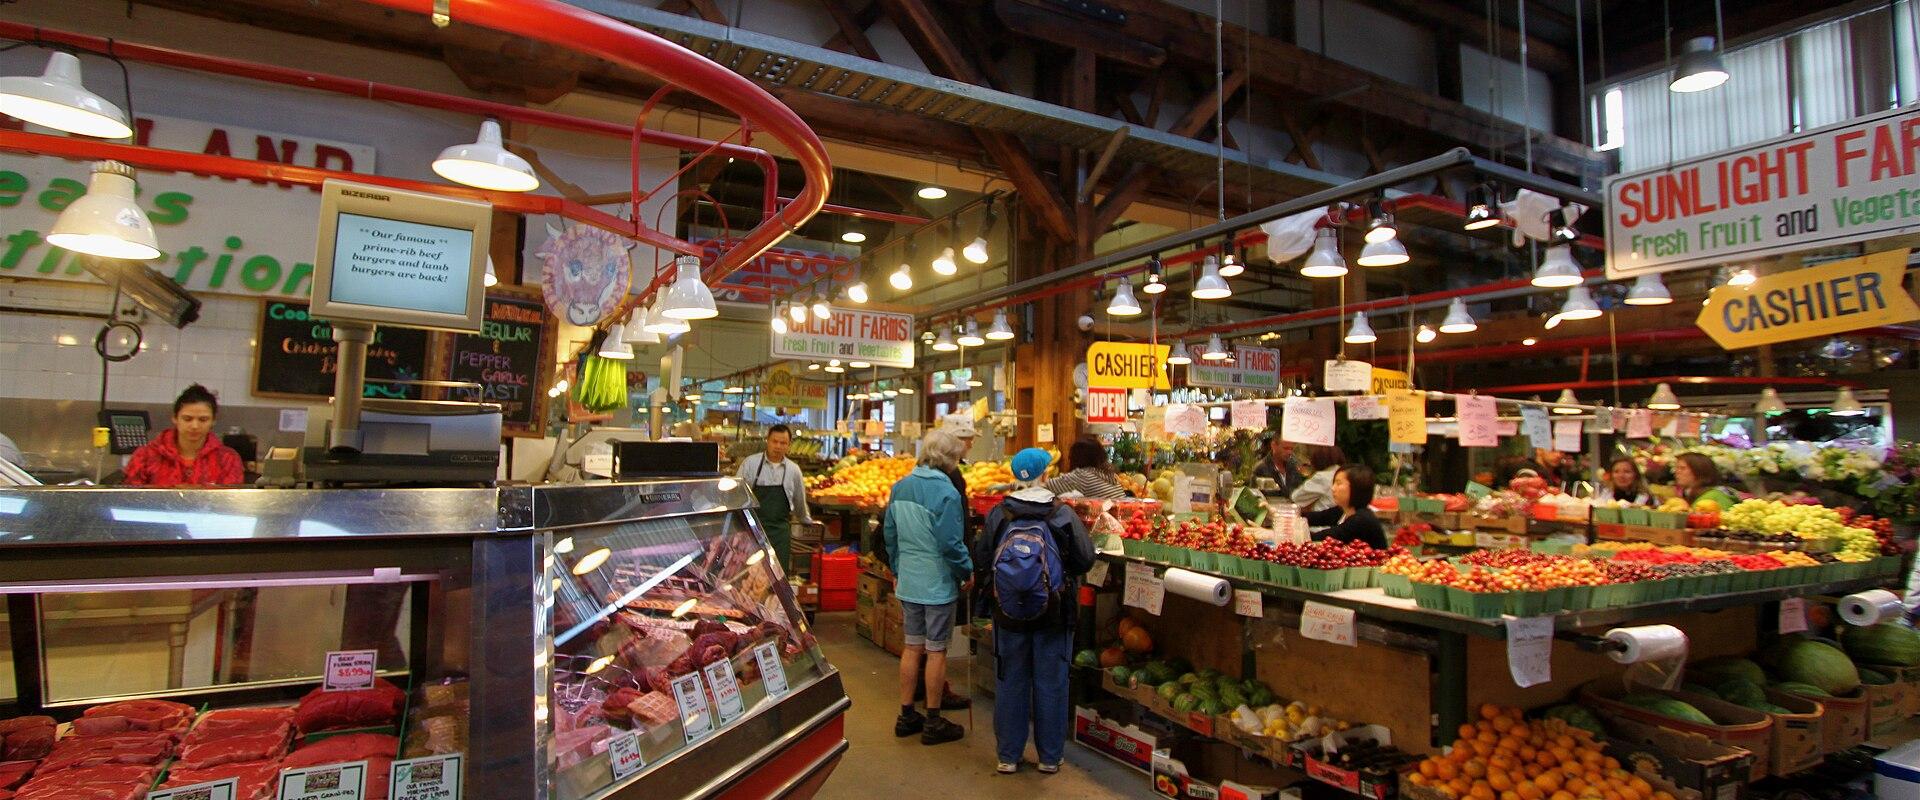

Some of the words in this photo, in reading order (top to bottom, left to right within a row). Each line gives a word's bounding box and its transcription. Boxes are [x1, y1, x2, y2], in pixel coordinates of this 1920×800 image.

[1619, 140, 1816, 229] SUNLIGHT
[340, 189, 391, 202] BIZERBA
[371, 230, 393, 239] Our
[394, 232, 436, 245] famous
[1632, 229, 1689, 260] Fresh
[1700, 214, 1763, 250] Fruit
[1776, 204, 1819, 238] and
[362, 243, 416, 257] prime-rib
[418, 249, 444, 261] beef
[352, 253, 396, 266] burgers
[398, 259, 420, 269] and
[421, 260, 449, 272] lamb
[351, 264, 395, 277] burgers
[398, 270, 416, 279] are
[418, 271, 448, 283] back!
[1722, 272, 1887, 333] CASHIER
[481, 321, 532, 341] EGULAR
[860, 314, 908, 342] FARMS
[783, 337, 807, 351] Fresh
[811, 338, 836, 354] Fruit
[838, 341, 855, 356] and
[459, 351, 511, 369] PEPPER
[1094, 353, 1159, 378] CASHIER
[1245, 350, 1277, 372] FARMS
[481, 368, 528, 386] GARLIC
[1088, 392, 1126, 418] OPEN
